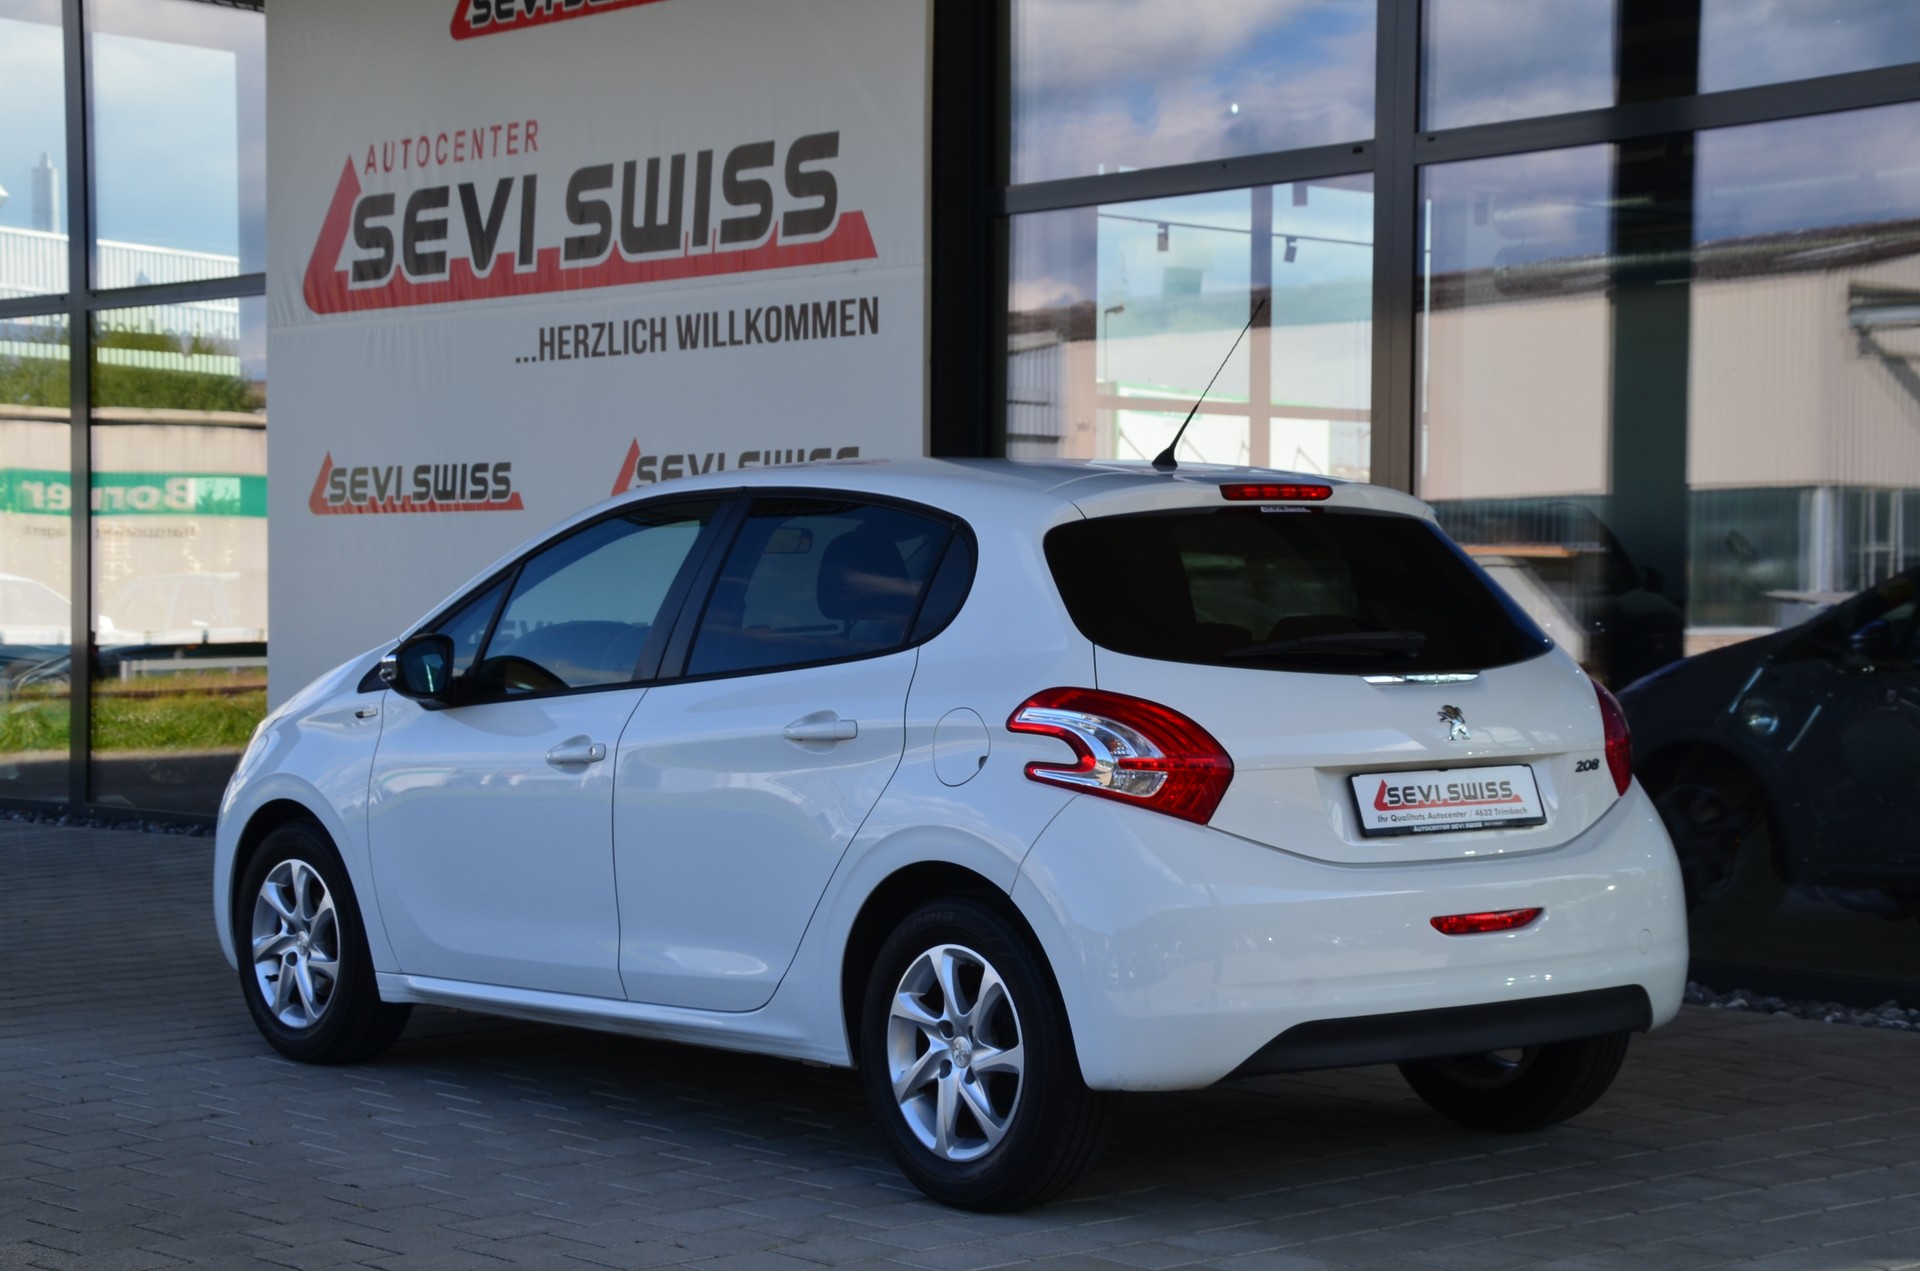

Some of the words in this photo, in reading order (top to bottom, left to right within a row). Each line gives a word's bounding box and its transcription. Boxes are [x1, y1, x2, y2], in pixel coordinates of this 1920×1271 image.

[364, 120, 539, 175] AUTOCENTER
[352, 174, 537, 282] SEVI
[564, 131, 840, 260] SWISS
[676, 296, 879, 350] WILLKOMMEN
[329, 465, 403, 502] SEVI
[412, 462, 511, 500] SWISS
[1575, 758, 1599, 773] 208
[1387, 784, 1441, 805] SEVI
[1447, 781, 1513, 801] SWISS
[1377, 815, 1388, 823] Ihr
[1428, 811, 1467, 819] Autocenter
[1494, 806, 1528, 815] Trimbach
